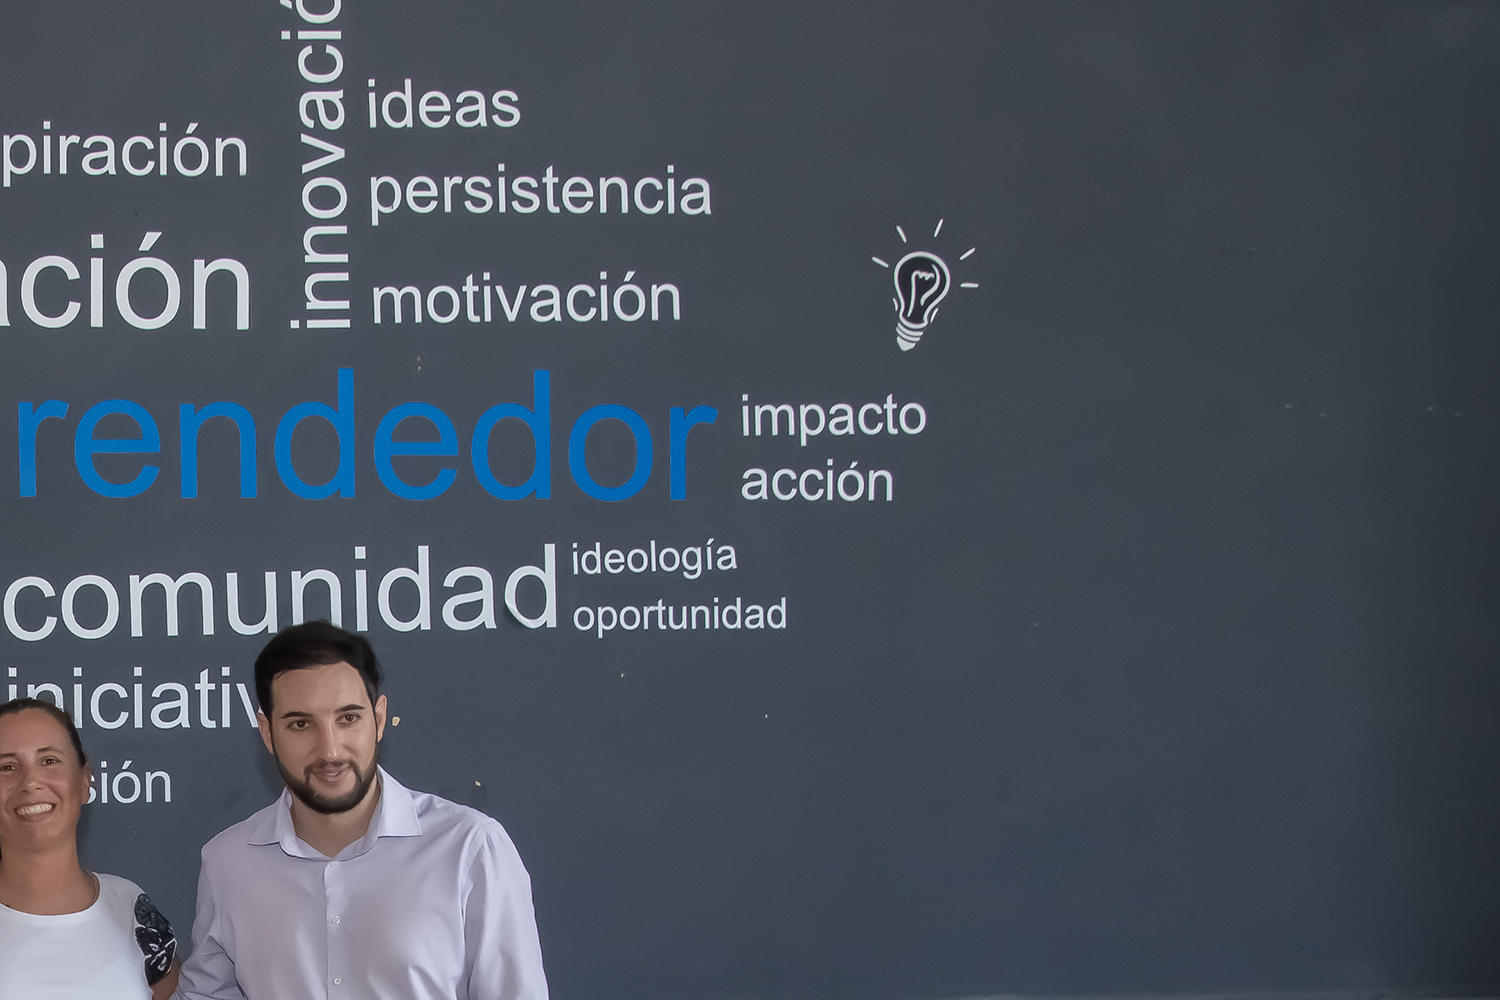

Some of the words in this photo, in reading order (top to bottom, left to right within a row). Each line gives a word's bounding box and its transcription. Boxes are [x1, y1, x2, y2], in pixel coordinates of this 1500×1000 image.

[368, 79, 521, 129] ideas
[279, 0, 351, 329] innovació
[370, 164, 712, 226] persistencia
[373, 271, 681, 324] motivación
[742, 394, 927, 440] impacto
[741, 459, 893, 502] acción
[572, 538, 738, 578] ideología
[3, 543, 557, 642] comunidad
[573, 597, 787, 639] oportunidad
[8, 666, 263, 730] iniciativ
